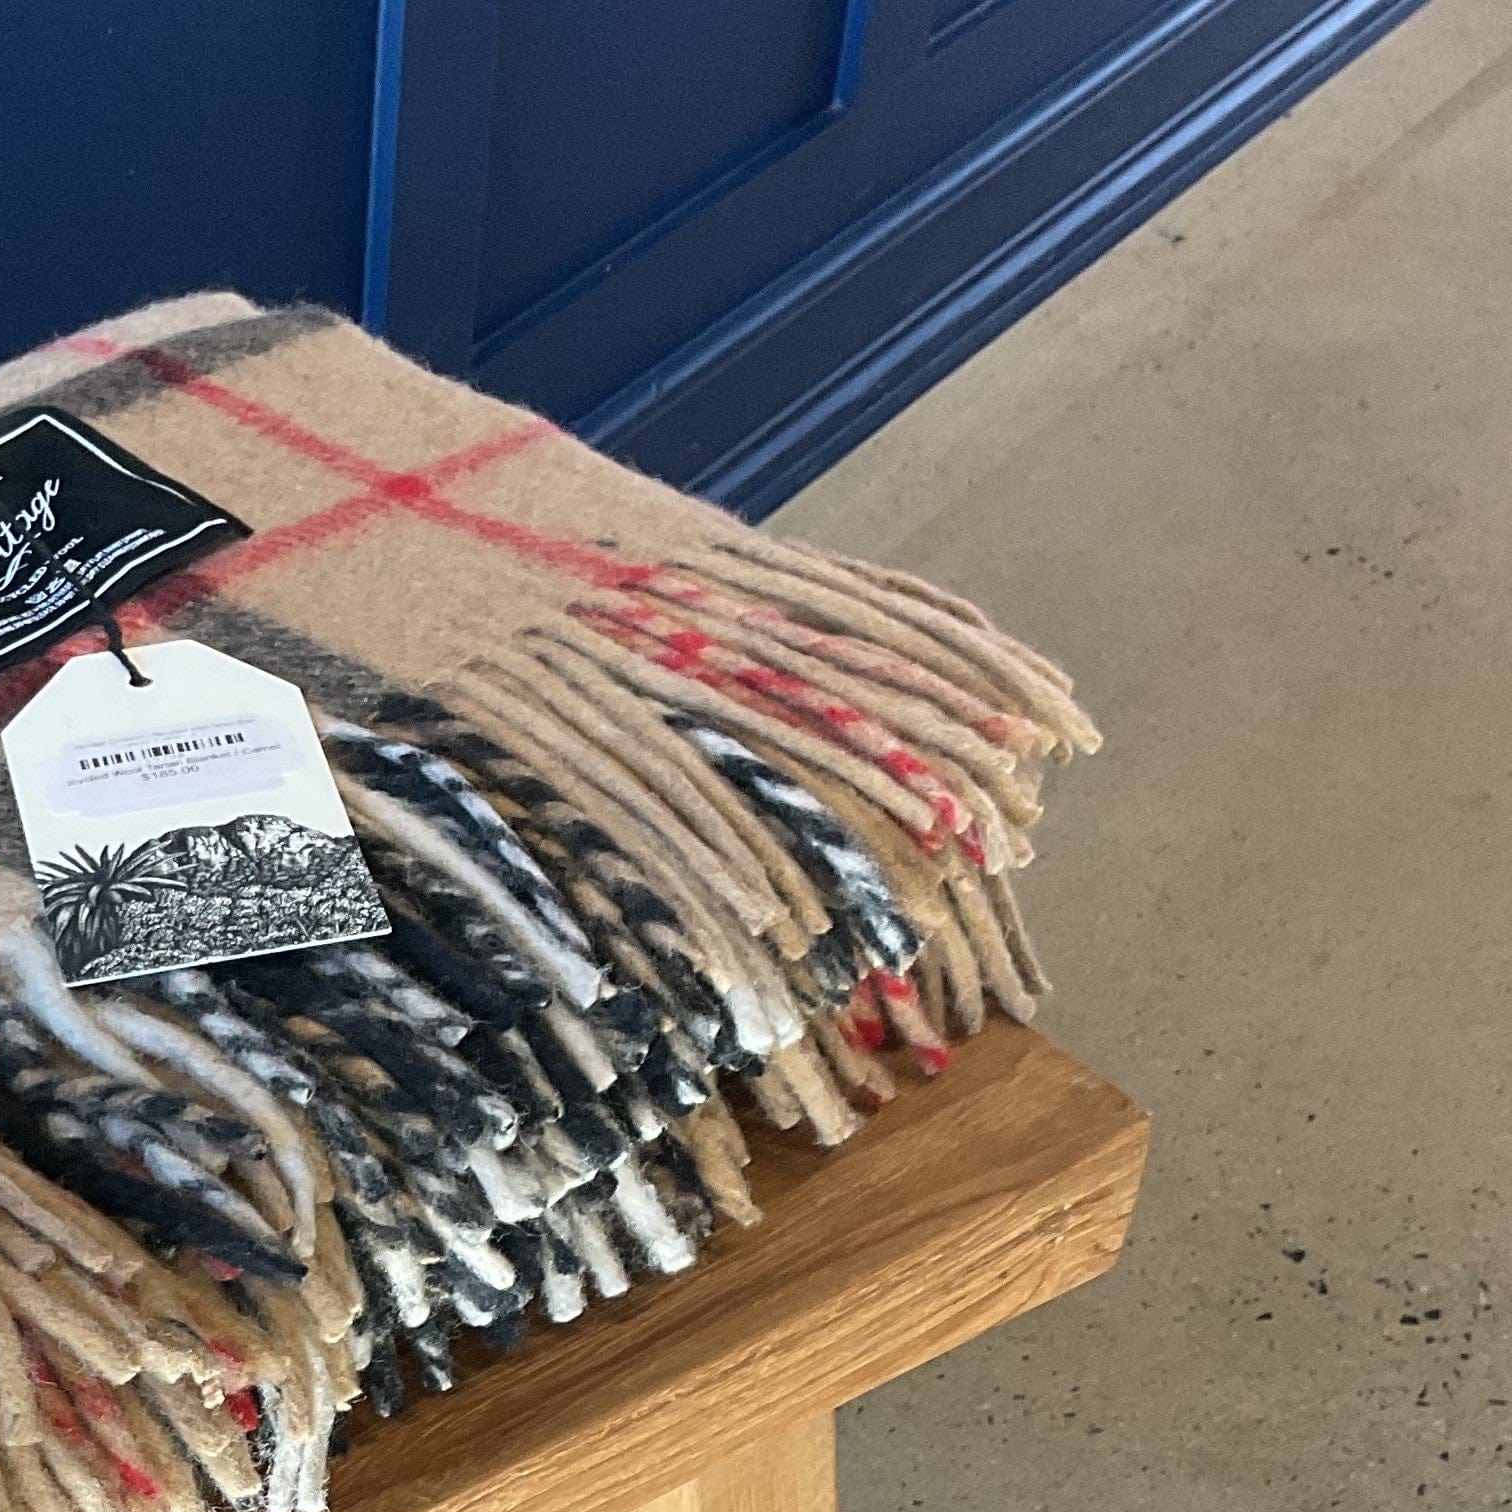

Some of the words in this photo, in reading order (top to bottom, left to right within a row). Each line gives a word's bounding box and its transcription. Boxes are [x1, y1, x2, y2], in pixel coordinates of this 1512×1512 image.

[45, 536, 84, 565] OOL
[113, 766, 143, 778] Wool
[241, 743, 281, 756] Camel
